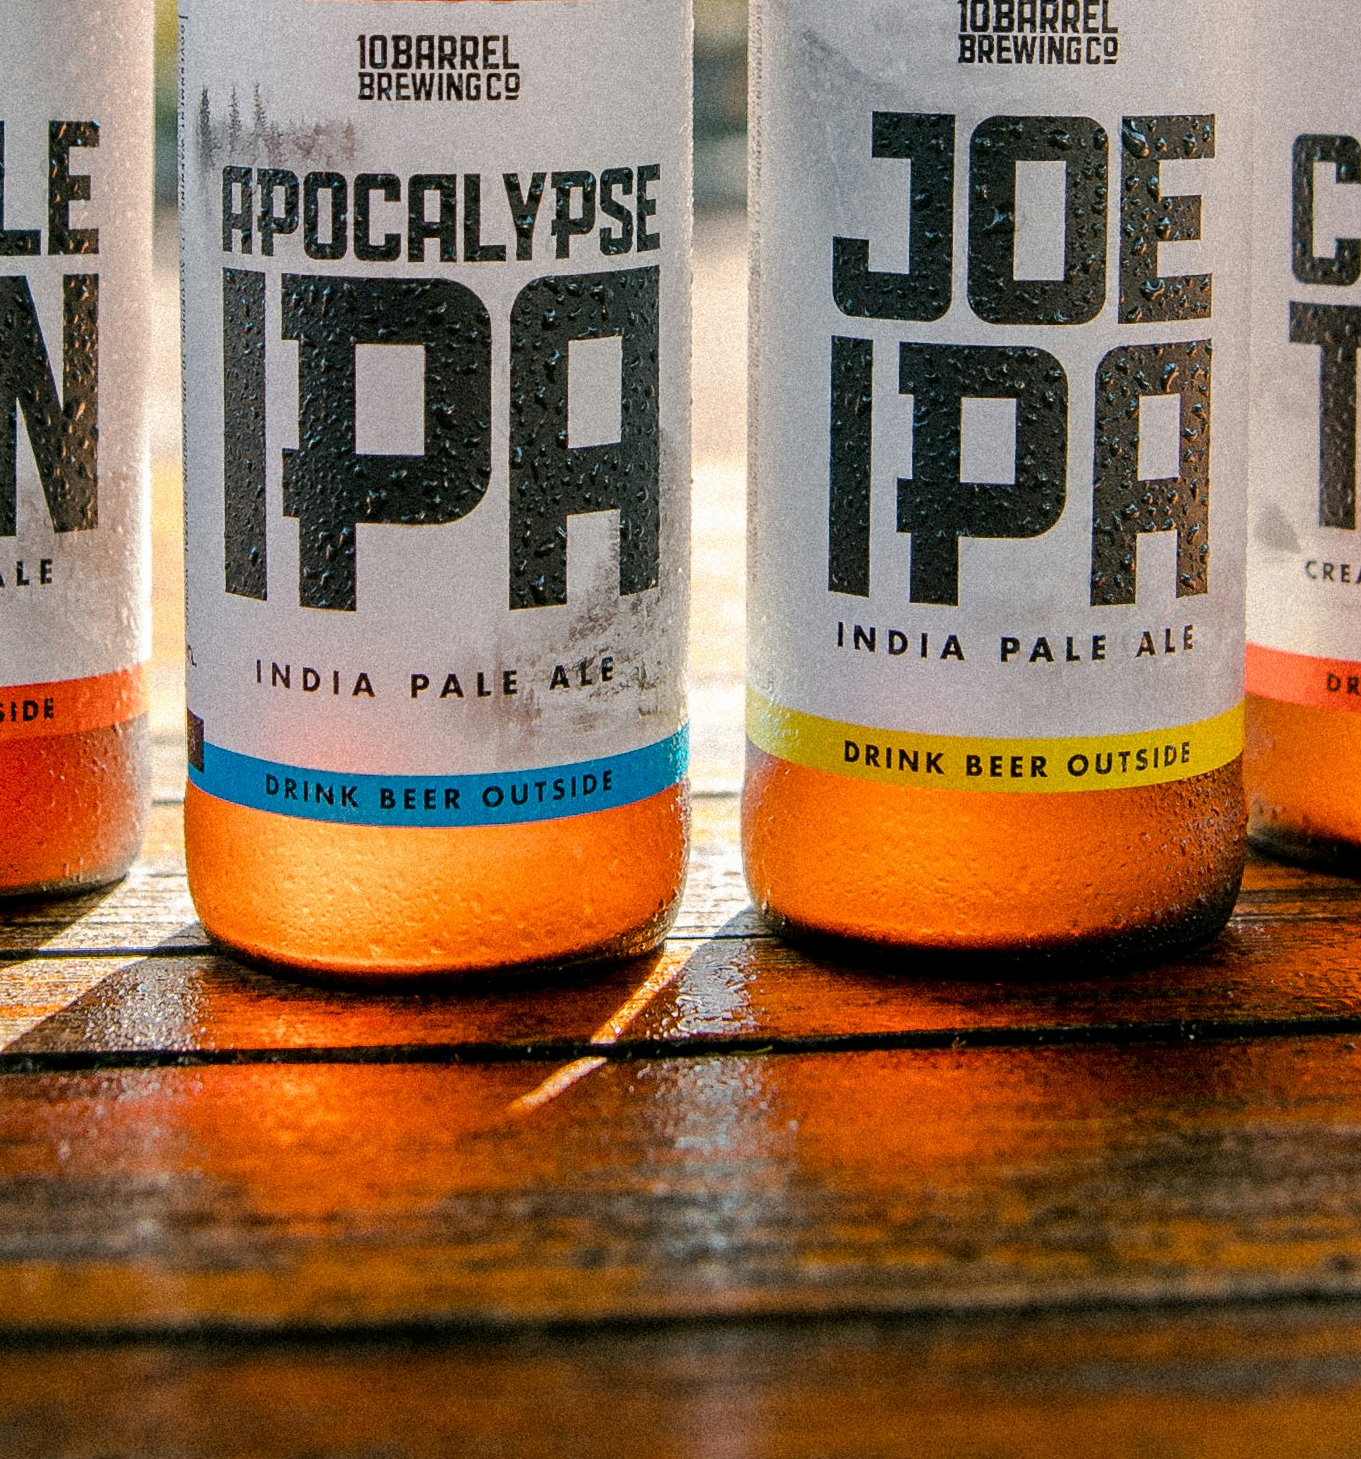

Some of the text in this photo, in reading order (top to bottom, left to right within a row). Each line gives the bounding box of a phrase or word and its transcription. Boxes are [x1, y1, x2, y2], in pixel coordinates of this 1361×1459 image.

[221, 163, 661, 262] APOCALYPSE
[831, 110, 1216, 326] JOE
[222, 266, 661, 612] IPA
[828, 334, 1213, 607] IPA
[255, 655, 614, 699] INDIA PALE ALE
[837, 621, 1194, 663] INDIA PALE ALE
[265, 770, 613, 810] DRINK BEER OUTSIDE
[844, 740, 1191, 778] DRINK BEER OUTSIDE
